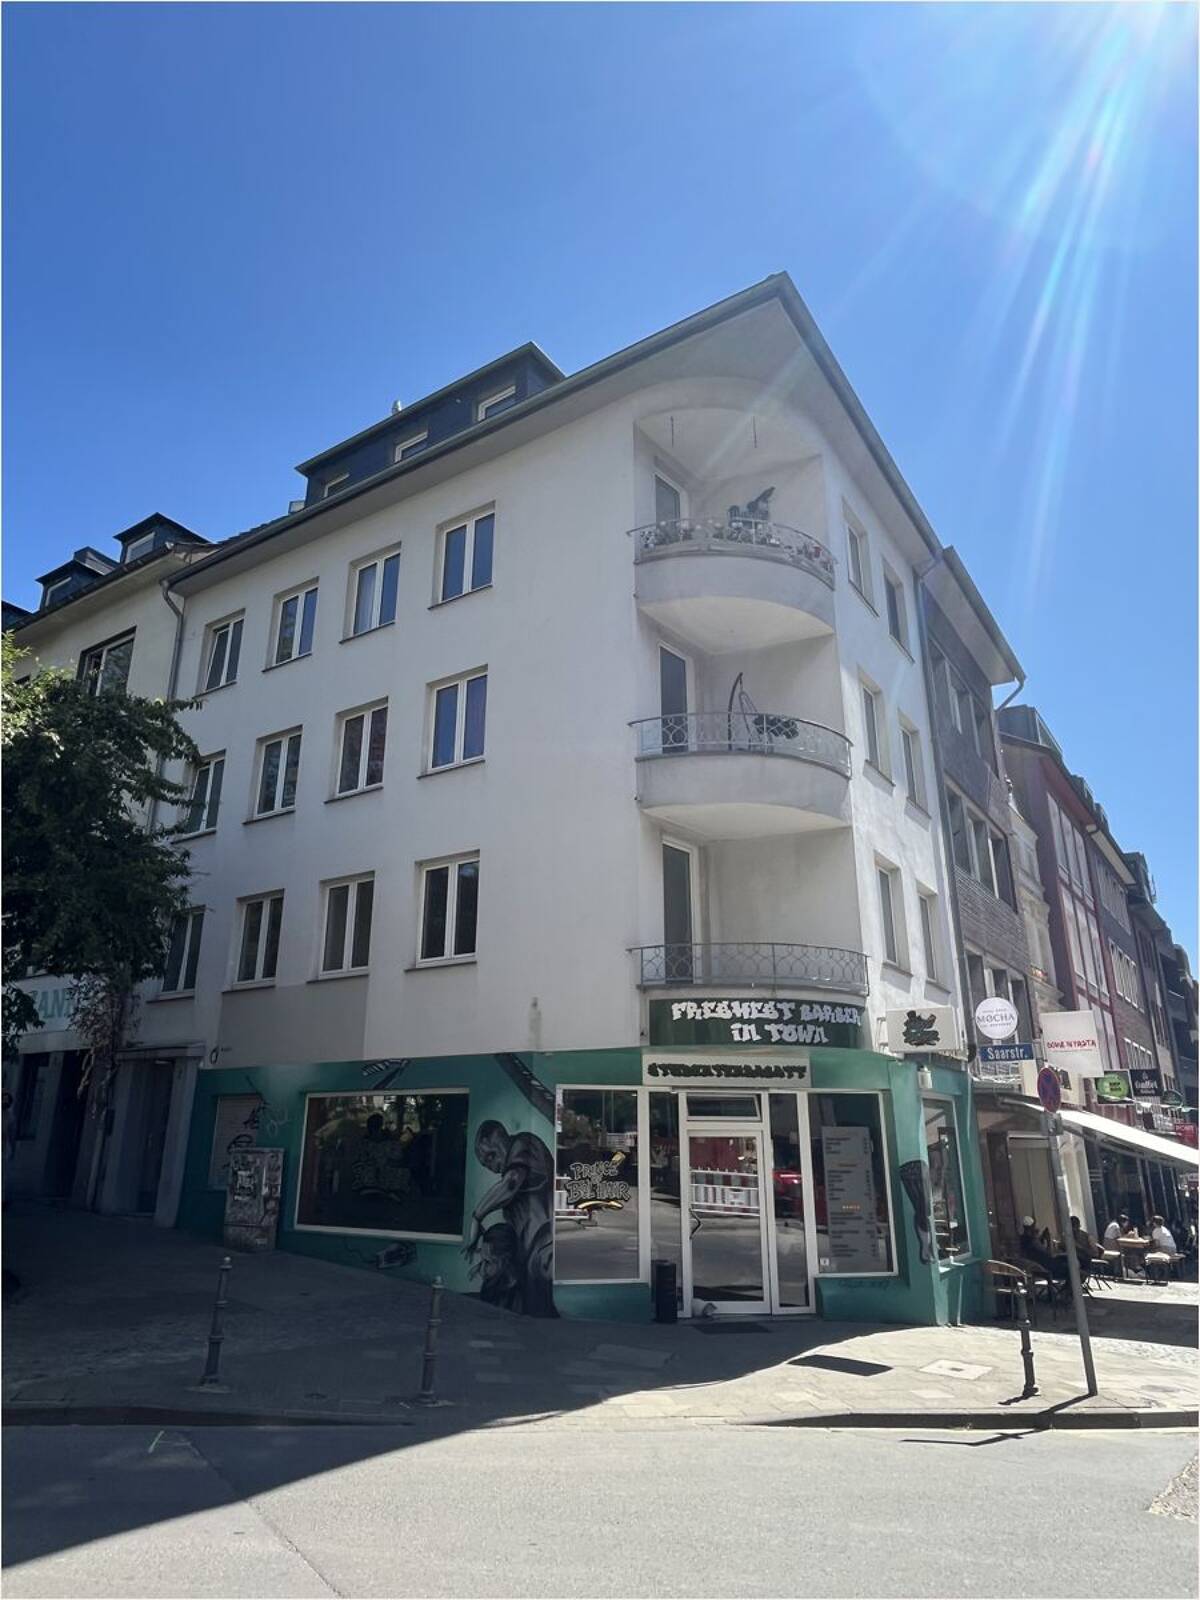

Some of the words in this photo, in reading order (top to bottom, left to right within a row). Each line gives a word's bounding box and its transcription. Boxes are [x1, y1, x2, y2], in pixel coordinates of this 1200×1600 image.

[671, 1001, 795, 1021] FRESHEST
[800, 1004, 861, 1026] BARBER
[987, 1047, 1028, 1060] Saarstr.
